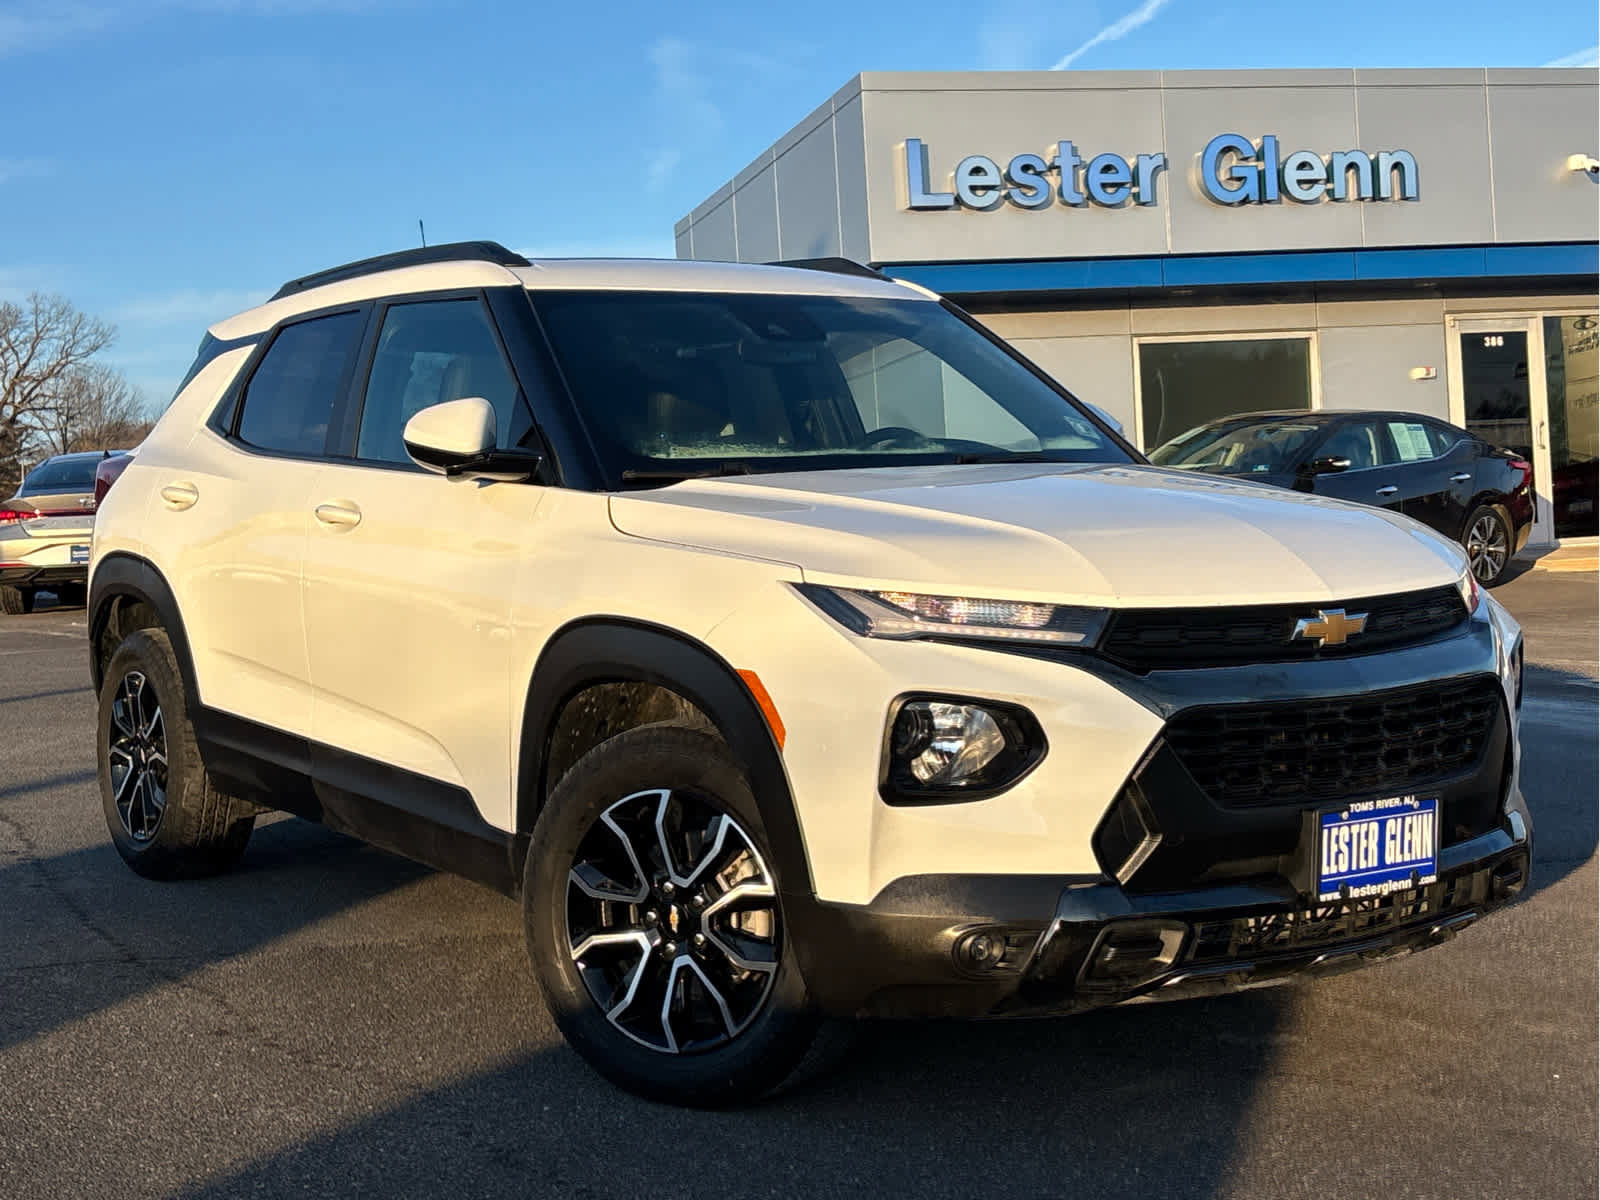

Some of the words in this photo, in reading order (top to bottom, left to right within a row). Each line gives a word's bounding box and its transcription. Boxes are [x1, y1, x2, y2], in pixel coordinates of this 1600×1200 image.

[905, 138, 1167, 210] Lester
[1201, 133, 1420, 206] Glenn
[1350, 802, 1374, 813] TOMS
[1404, 795, 1416, 806] NJ
[1321, 821, 1379, 875] LESTER
[1385, 813, 1433, 865] GLENN
[1349, 879, 1411, 898] lesterglenn
